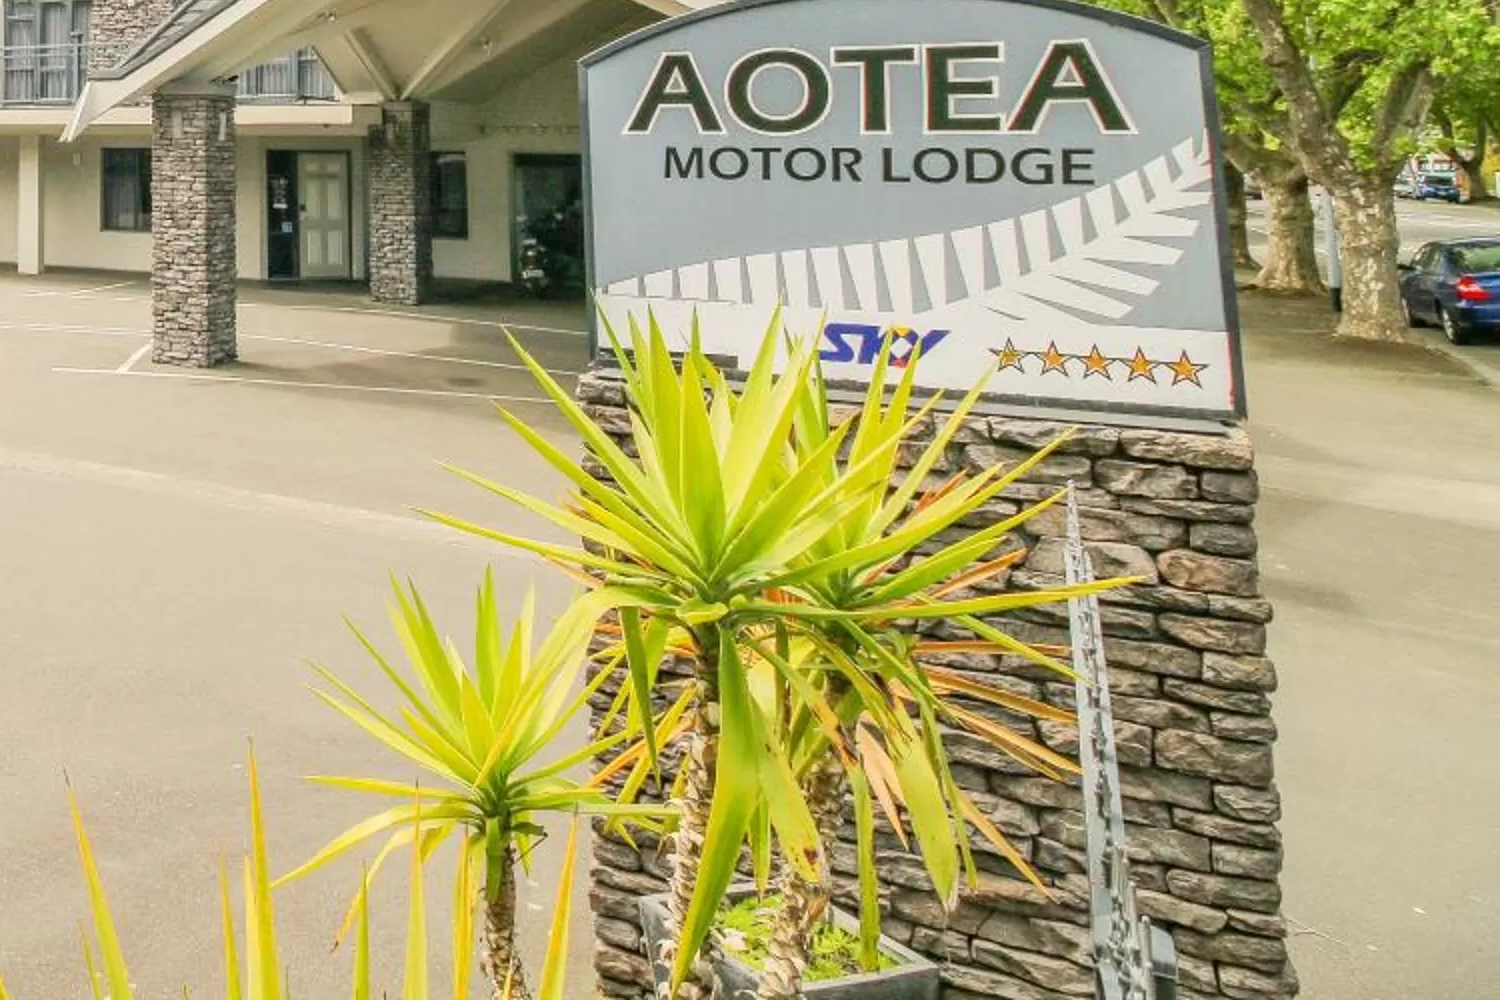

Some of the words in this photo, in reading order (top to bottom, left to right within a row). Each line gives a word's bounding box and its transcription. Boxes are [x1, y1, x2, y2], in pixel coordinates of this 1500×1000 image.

[624, 39, 1138, 135] AOTEA
[663, 146, 862, 182] MOTOR
[882, 147, 1096, 186] LODGE
